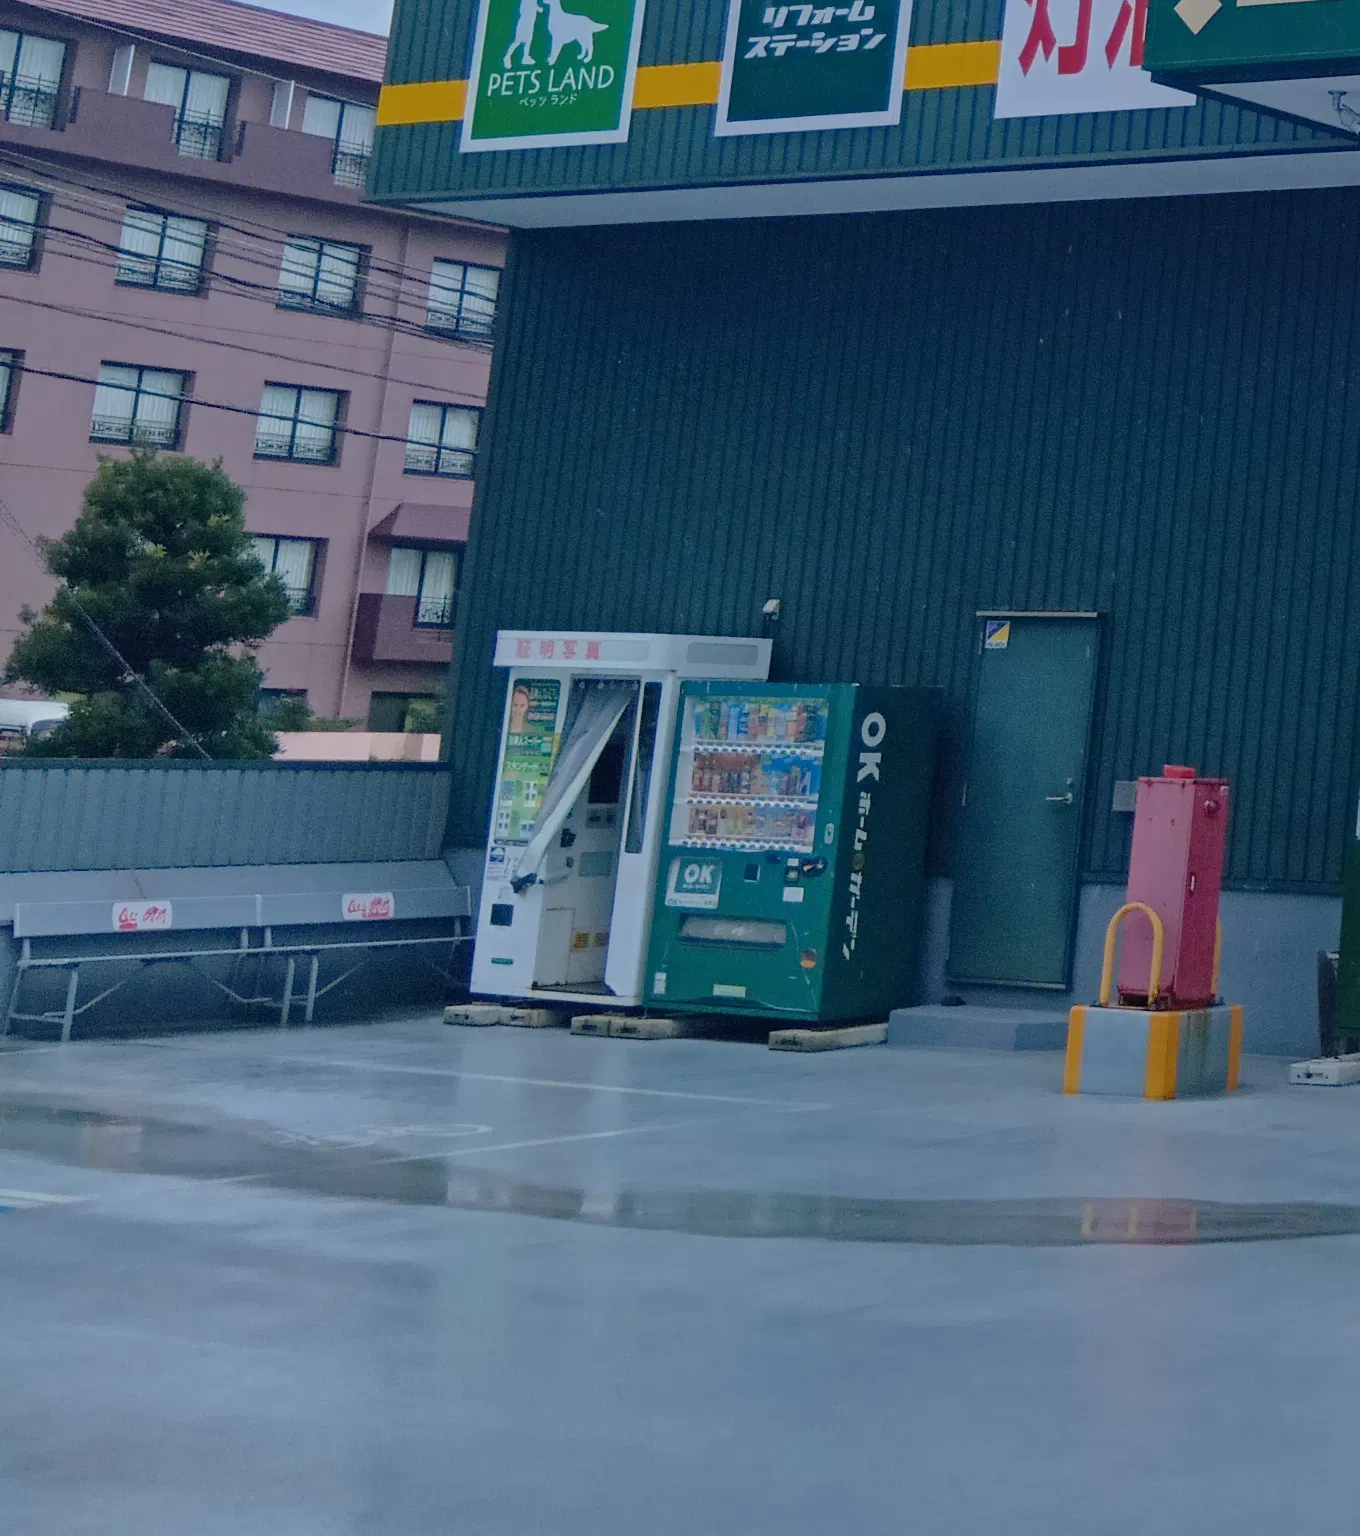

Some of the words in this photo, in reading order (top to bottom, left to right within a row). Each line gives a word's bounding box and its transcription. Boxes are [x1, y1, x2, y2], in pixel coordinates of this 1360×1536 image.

[762, 0, 876, 29] リフォーム
[744, 28, 888, 59] ステーション
[487, 69, 542, 97] PETS
[548, 64, 615, 93] LAND
[856, 711, 887, 784] OK
[684, 863, 715, 883] OK
